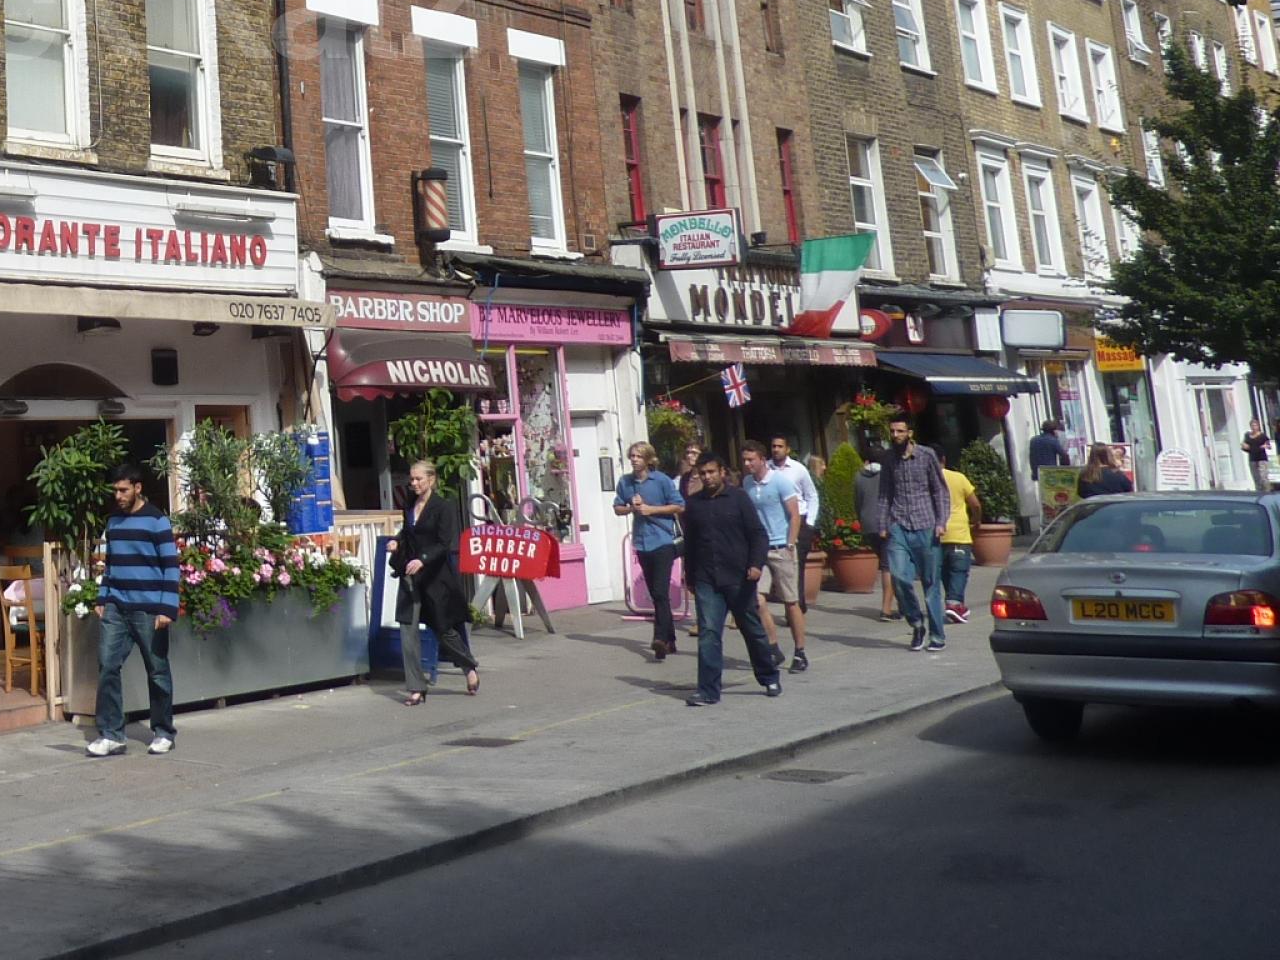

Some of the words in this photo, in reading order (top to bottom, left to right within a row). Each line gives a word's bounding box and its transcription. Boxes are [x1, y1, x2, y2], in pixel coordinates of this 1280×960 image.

[662, 217, 731, 243] MONDELLO
[679, 232, 711, 242] ITALIAN
[134, 227, 268, 268] ITALIANO
[672, 240, 720, 252] RESTAURANT
[229, 302, 255, 319] 020
[256, 303, 285, 320] 7637
[291, 307, 322, 324] 7405
[329, 294, 415, 323] BARBER
[417, 300, 465, 324] SHOP
[689, 283, 796, 327] MONDEL
[497, 305, 562, 326] MARVELOUS
[566, 309, 622, 329] JEWELLERY
[386, 360, 490, 386] NICHOLAS
[469, 536, 537, 559] BARBER
[478, 555, 521, 574] SHOP
[1080, 600, 1121, 618] L20
[1125, 602, 1167, 620] MCG
